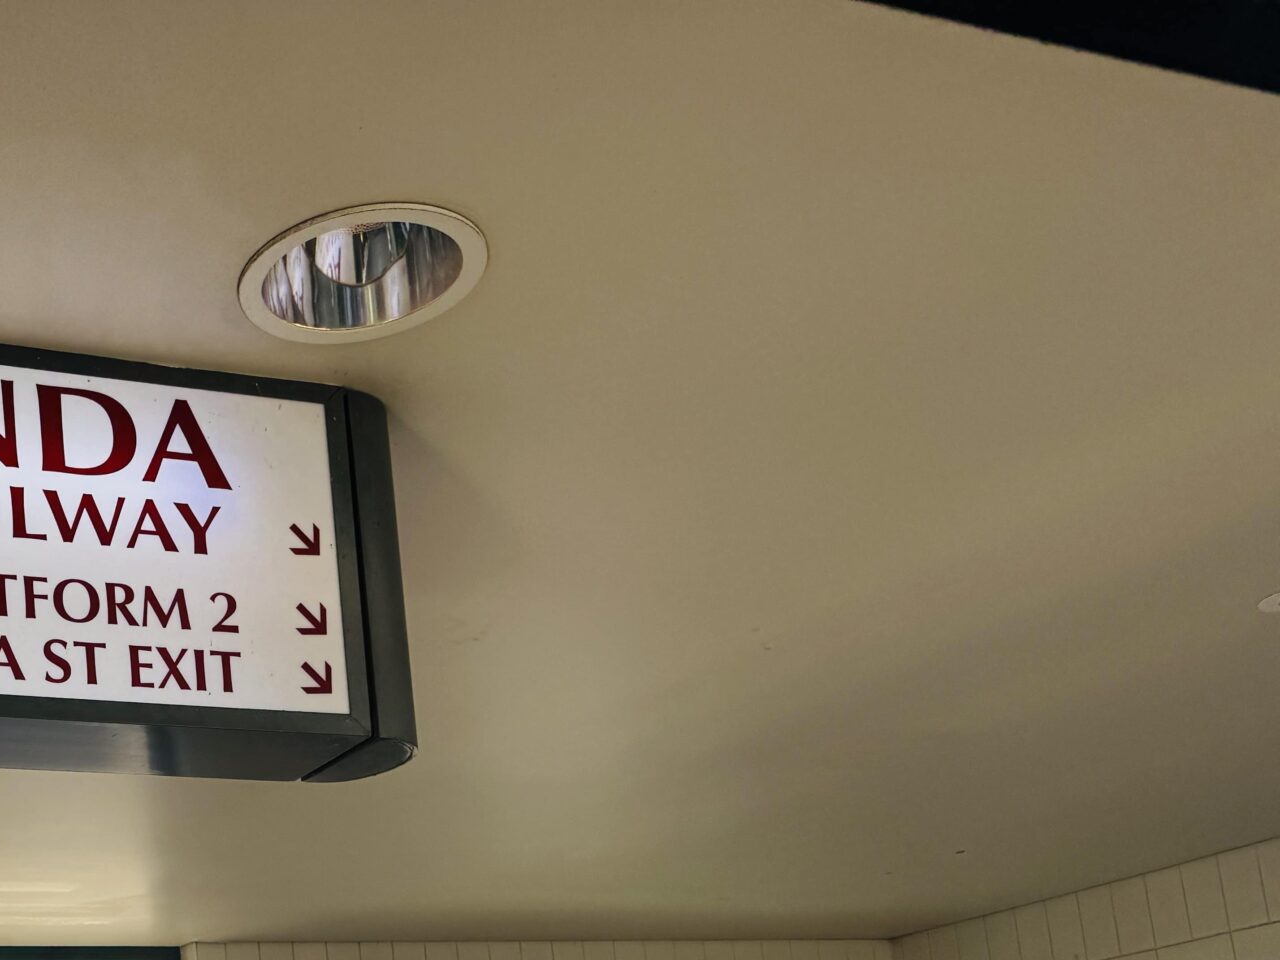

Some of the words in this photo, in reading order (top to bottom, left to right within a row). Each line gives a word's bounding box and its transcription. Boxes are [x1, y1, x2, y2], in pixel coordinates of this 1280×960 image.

[210, 593, 240, 634] 2
[44, 639, 106, 684] ST
[129, 646, 242, 694] EXIT
